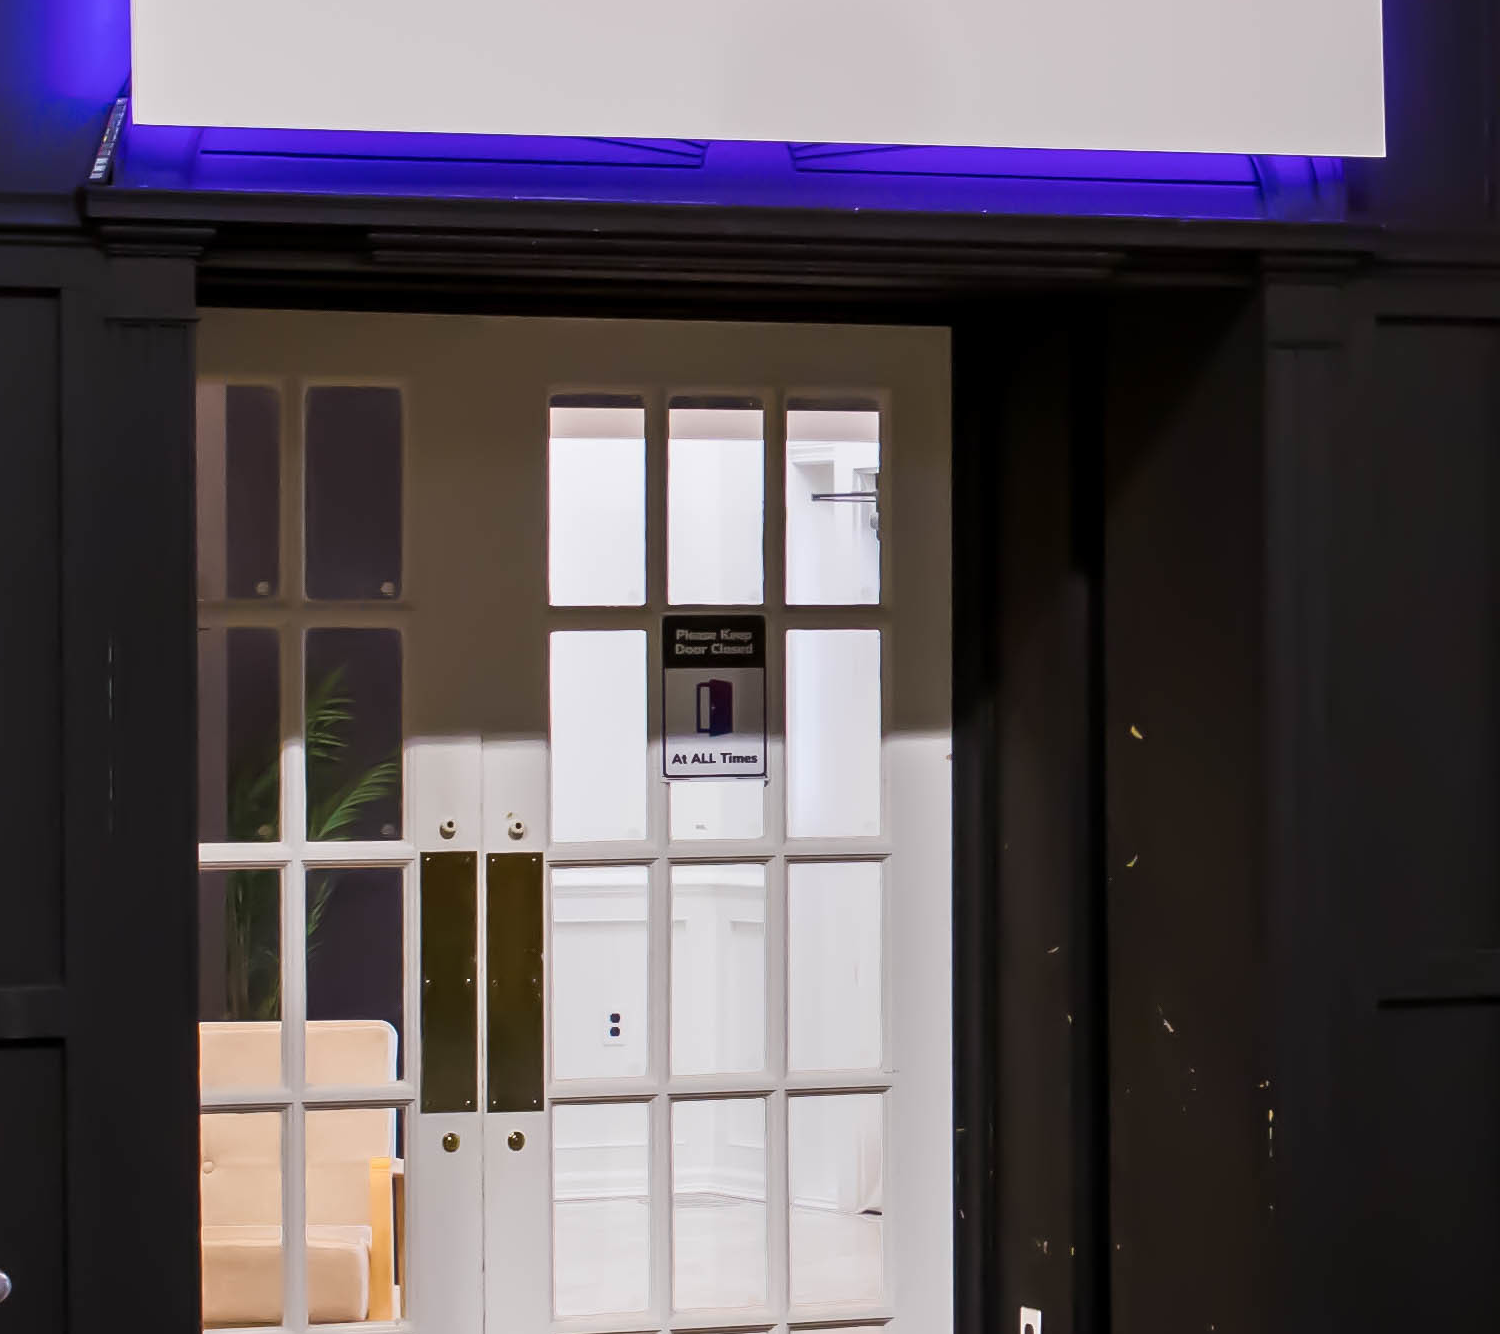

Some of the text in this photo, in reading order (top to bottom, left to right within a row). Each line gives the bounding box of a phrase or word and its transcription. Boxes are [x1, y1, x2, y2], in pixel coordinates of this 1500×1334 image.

[675, 643, 754, 655] Door Closed
[671, 752, 758, 765] At ALL Times
